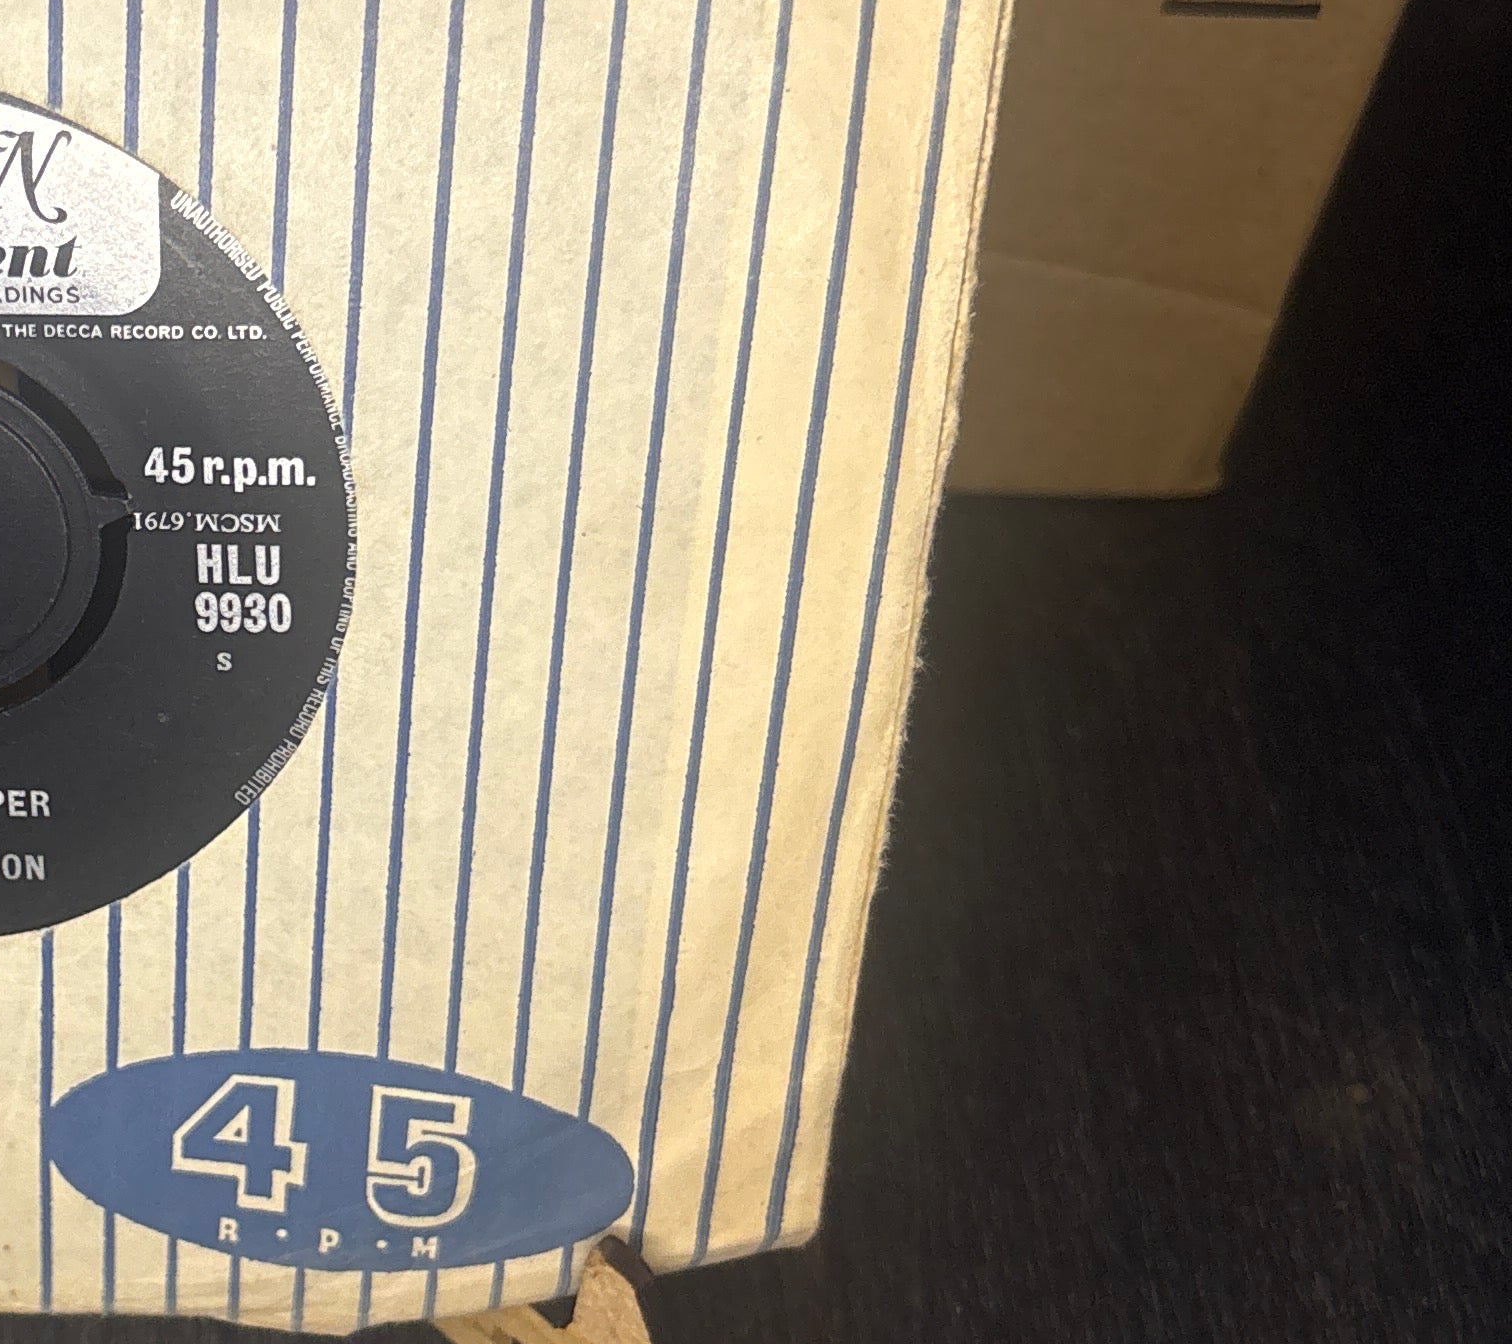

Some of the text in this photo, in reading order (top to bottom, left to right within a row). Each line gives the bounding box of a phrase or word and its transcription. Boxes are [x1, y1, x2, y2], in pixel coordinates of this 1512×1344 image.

[2, 323, 267, 340] THE DECCA RECORD CO. LTD.
[145, 447, 316, 492] 45 r.p.m.
[197, 544, 280, 585] HLU
[195, 592, 291, 633] 9930
[233, 737, 298, 806] PROHIBITED
